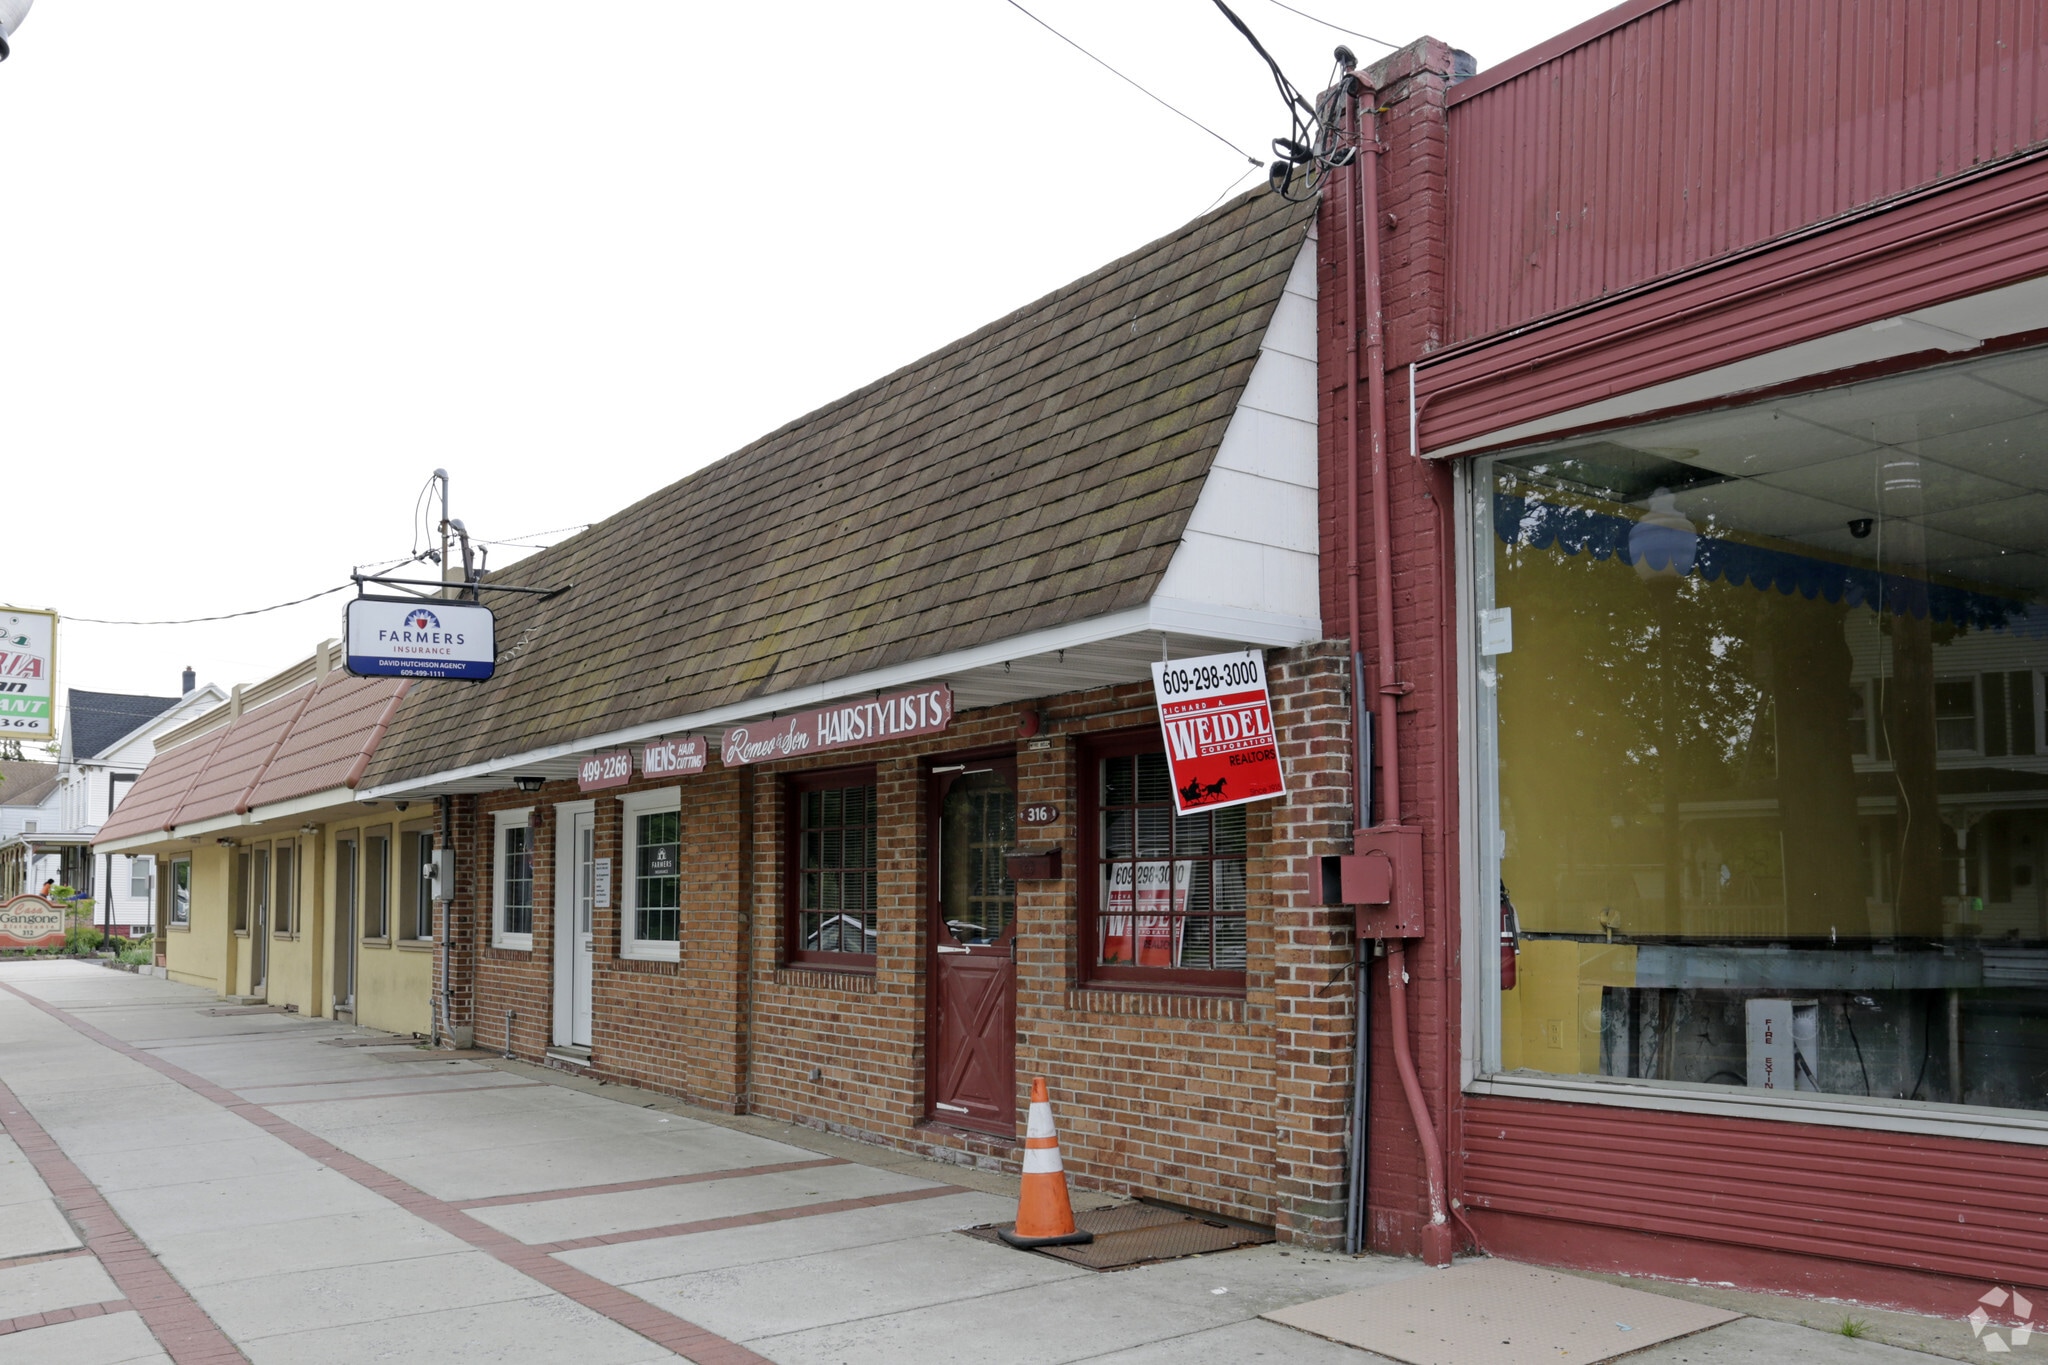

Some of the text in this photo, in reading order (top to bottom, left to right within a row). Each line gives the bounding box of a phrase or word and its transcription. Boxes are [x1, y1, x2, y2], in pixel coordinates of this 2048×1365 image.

[379, 629, 465, 645] FARMERS
[393, 645, 451, 655] INSURANCE
[378, 659, 466, 671] DAVID HUTCHISON AGENCY
[400, 668, 445, 678] 609-499-1111
[1162, 660, 1258, 695] 609-298-3000
[1163, 701, 1207, 715] RICHARD
[726, 728, 775, 764] Romeo
[781, 717, 810, 755] Son
[817, 690, 943, 747] HAIRSTYLISTS
[1165, 707, 1270, 762] WEIDEL
[677, 742, 695, 756] HAIR
[1201, 736, 1273, 755] CORPORATION
[645, 741, 676, 773] MEN'S
[676, 754, 702, 770] CUTTING
[1229, 749, 1276, 767] REALTORS
[1027, 806, 1048, 822] 316
[651, 860, 672, 868] FARMERS
[0, 913, 58, 924] Gangone
[1765, 1018, 1773, 1045] FIRE
